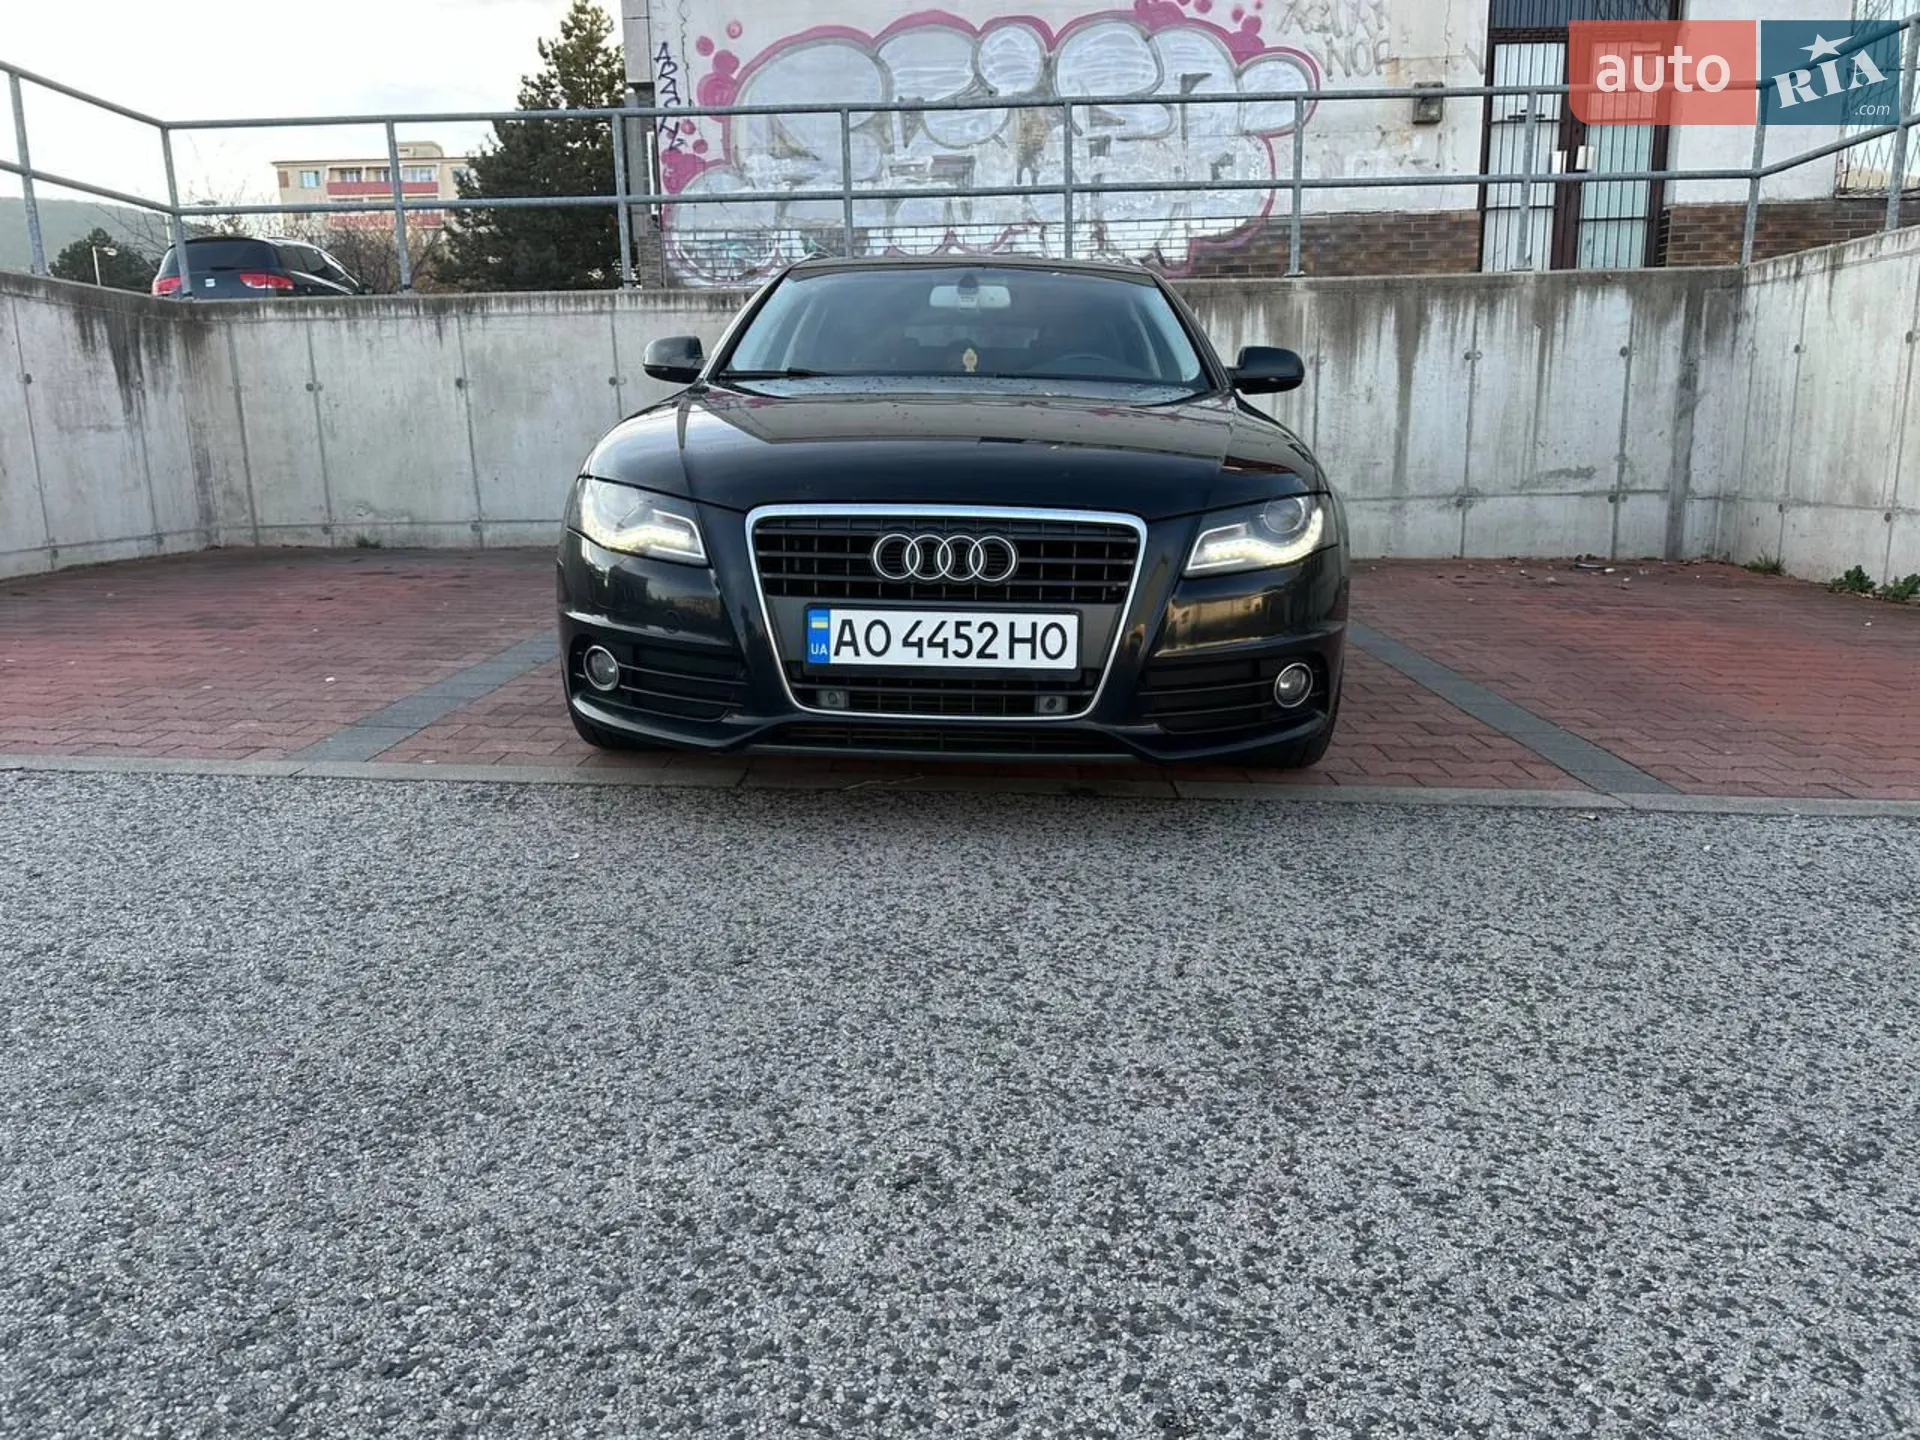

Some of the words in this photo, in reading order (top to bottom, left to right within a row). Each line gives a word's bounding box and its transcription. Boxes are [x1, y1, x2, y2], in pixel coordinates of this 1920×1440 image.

[810, 643, 828, 655] UA
[833, 618, 892, 657] AO
[901, 619, 999, 660] 4452
[1008, 621, 1068, 661] HO
